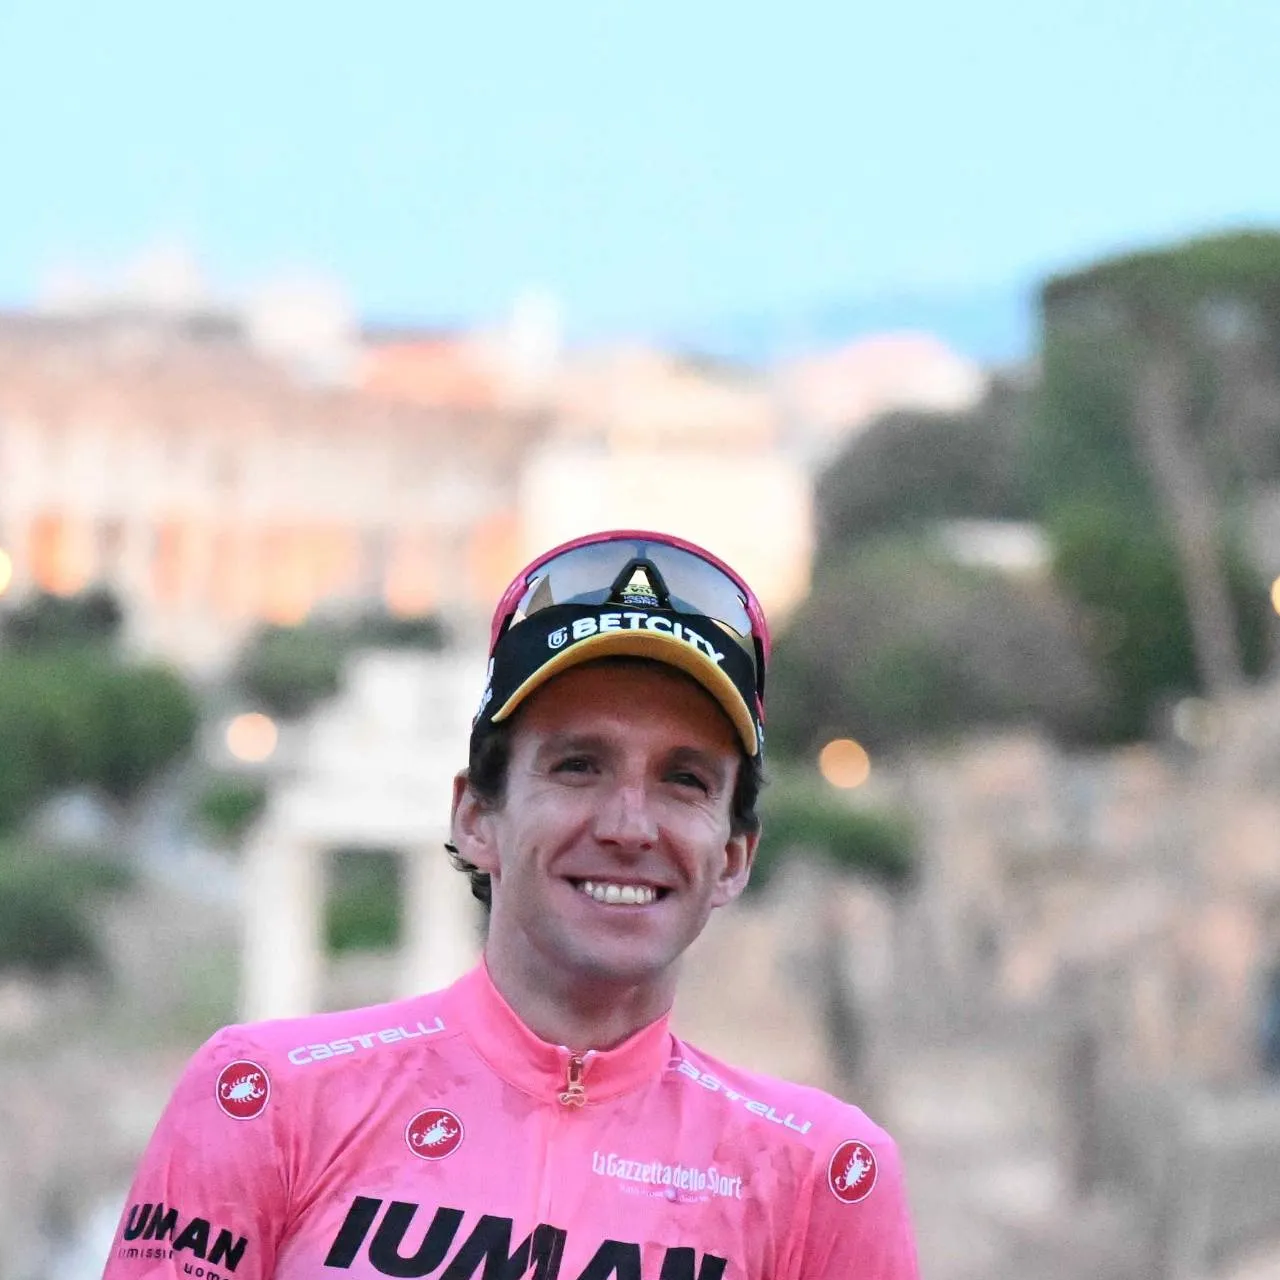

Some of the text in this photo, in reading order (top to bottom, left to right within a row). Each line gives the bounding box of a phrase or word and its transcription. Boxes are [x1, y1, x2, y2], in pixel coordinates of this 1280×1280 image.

[572, 612, 725, 664] BETCITY
[606, 1153, 671, 1185] Gazzetta
[672, 1164, 706, 1191] dello
[124, 1202, 248, 1272] UMAN
